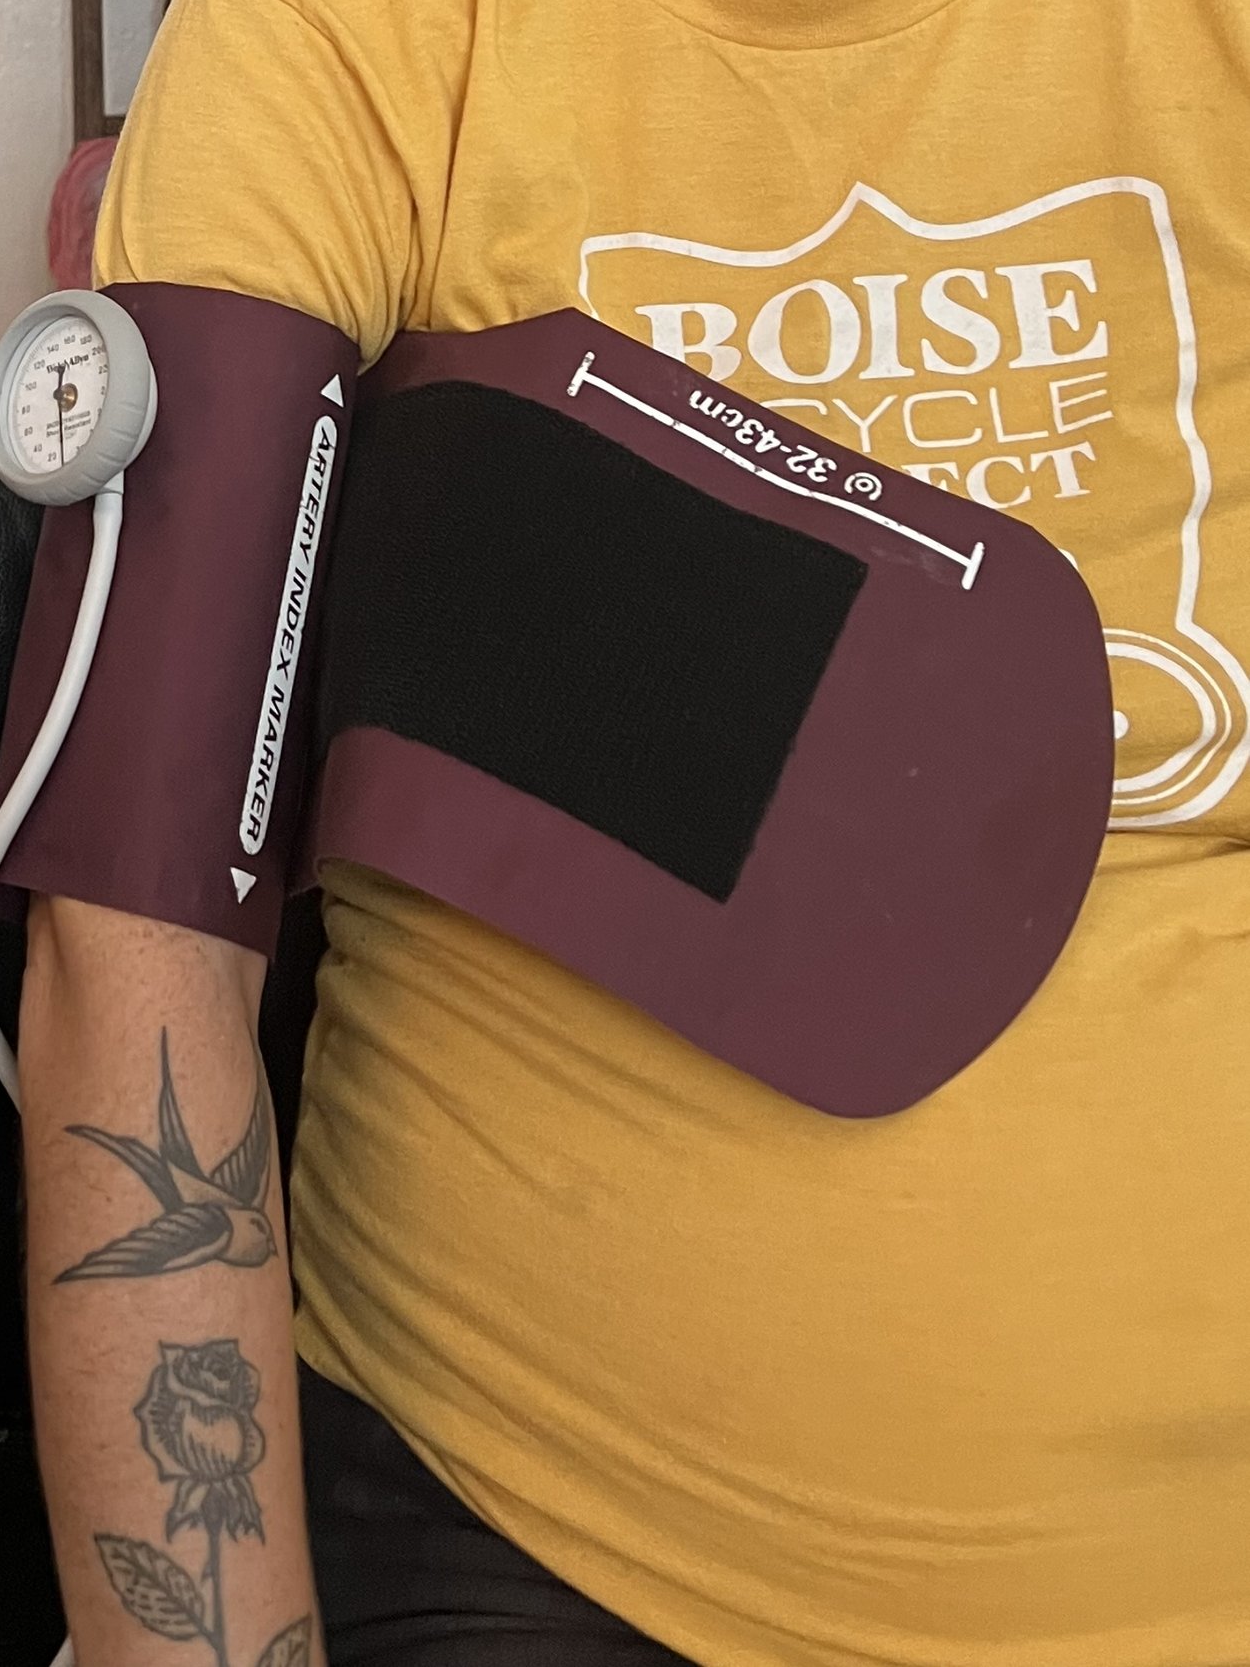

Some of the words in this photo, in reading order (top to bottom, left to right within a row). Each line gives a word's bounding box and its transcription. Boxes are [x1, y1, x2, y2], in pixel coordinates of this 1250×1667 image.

[634, 258, 1110, 385] BOISE
[299, 426, 331, 565] ARTERY
[688, 389, 838, 483] 32-43cm
[276, 566, 307, 681] INDEX
[246, 684, 286, 842] MARKER
